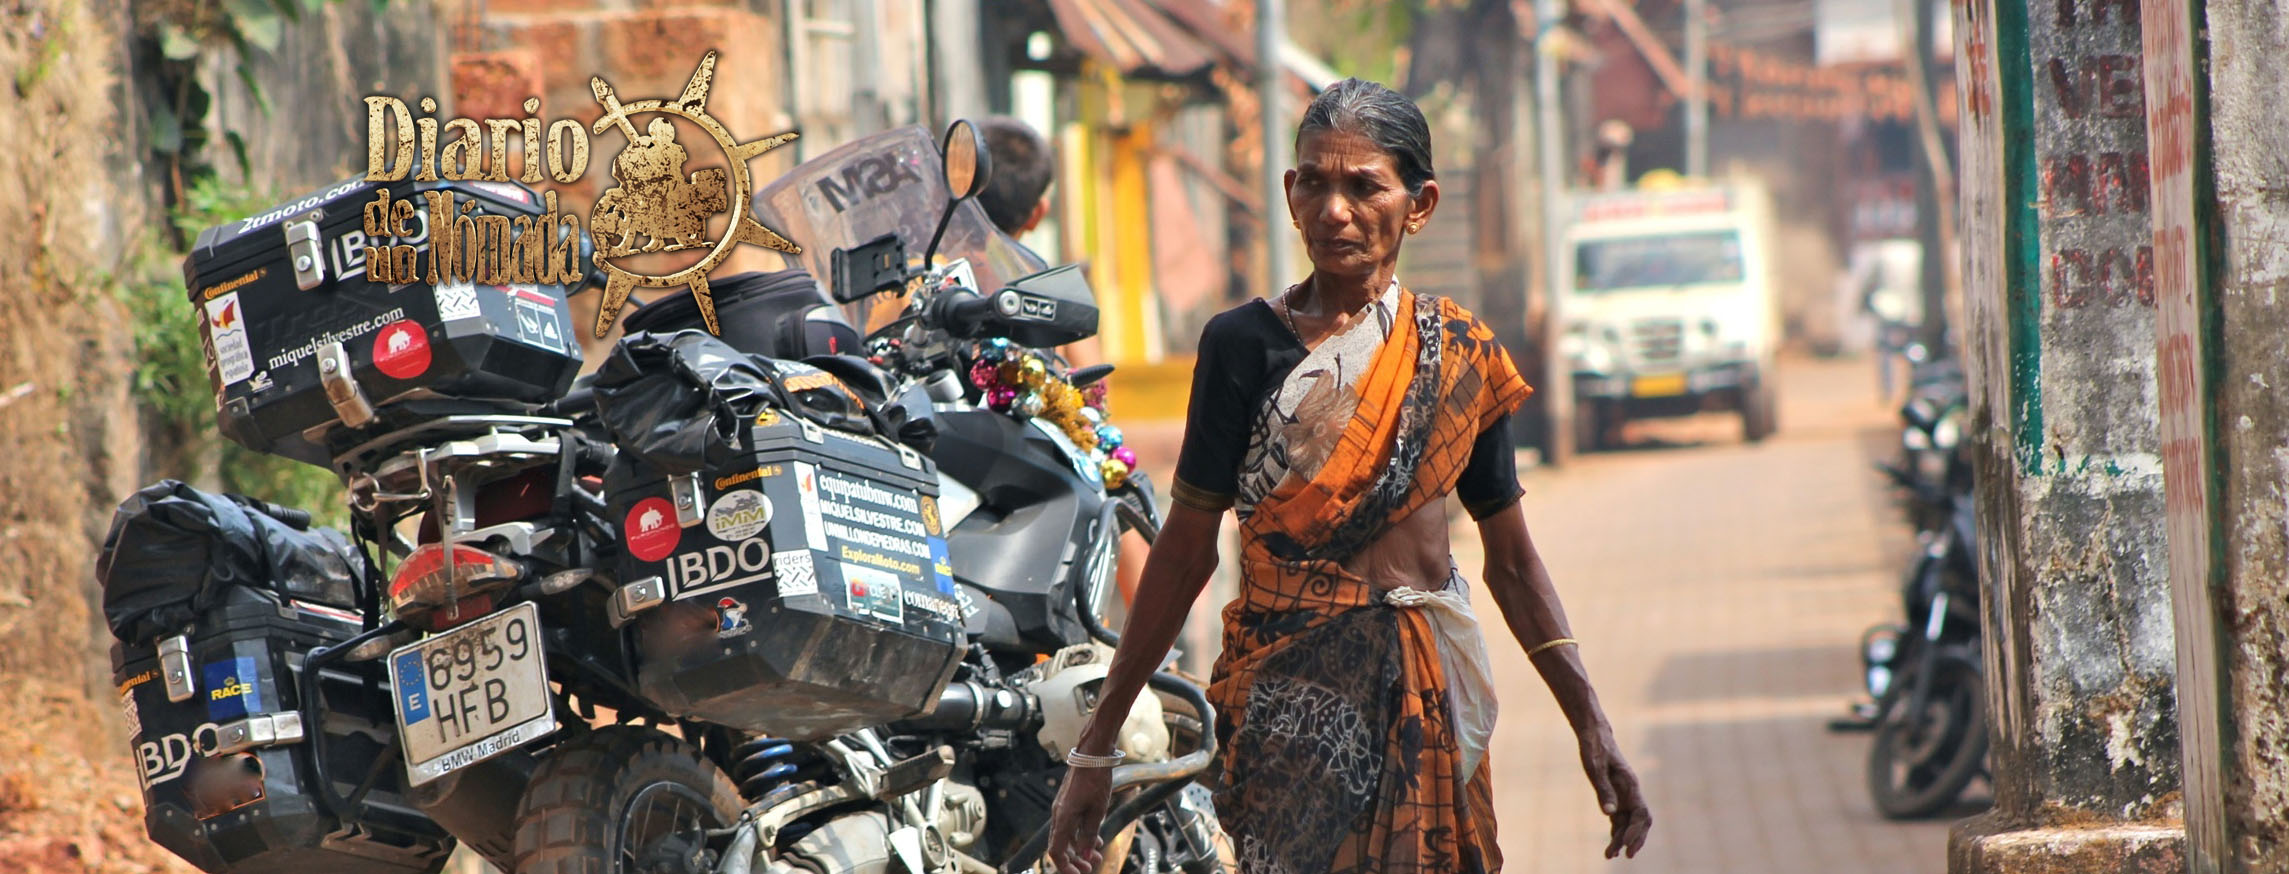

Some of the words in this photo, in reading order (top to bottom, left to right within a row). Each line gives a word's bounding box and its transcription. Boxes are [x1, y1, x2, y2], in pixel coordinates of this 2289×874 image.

[204, 270, 260, 299] Continental
[715, 466, 772, 490] Continental
[667, 537, 771, 592] BDO
[428, 618, 529, 690] 6959
[211, 683, 253, 700] RACE
[408, 693, 422, 711] E
[434, 678, 510, 743] HFB
[442, 748, 474, 772] BMW
[478, 730, 520, 757] Madrid
